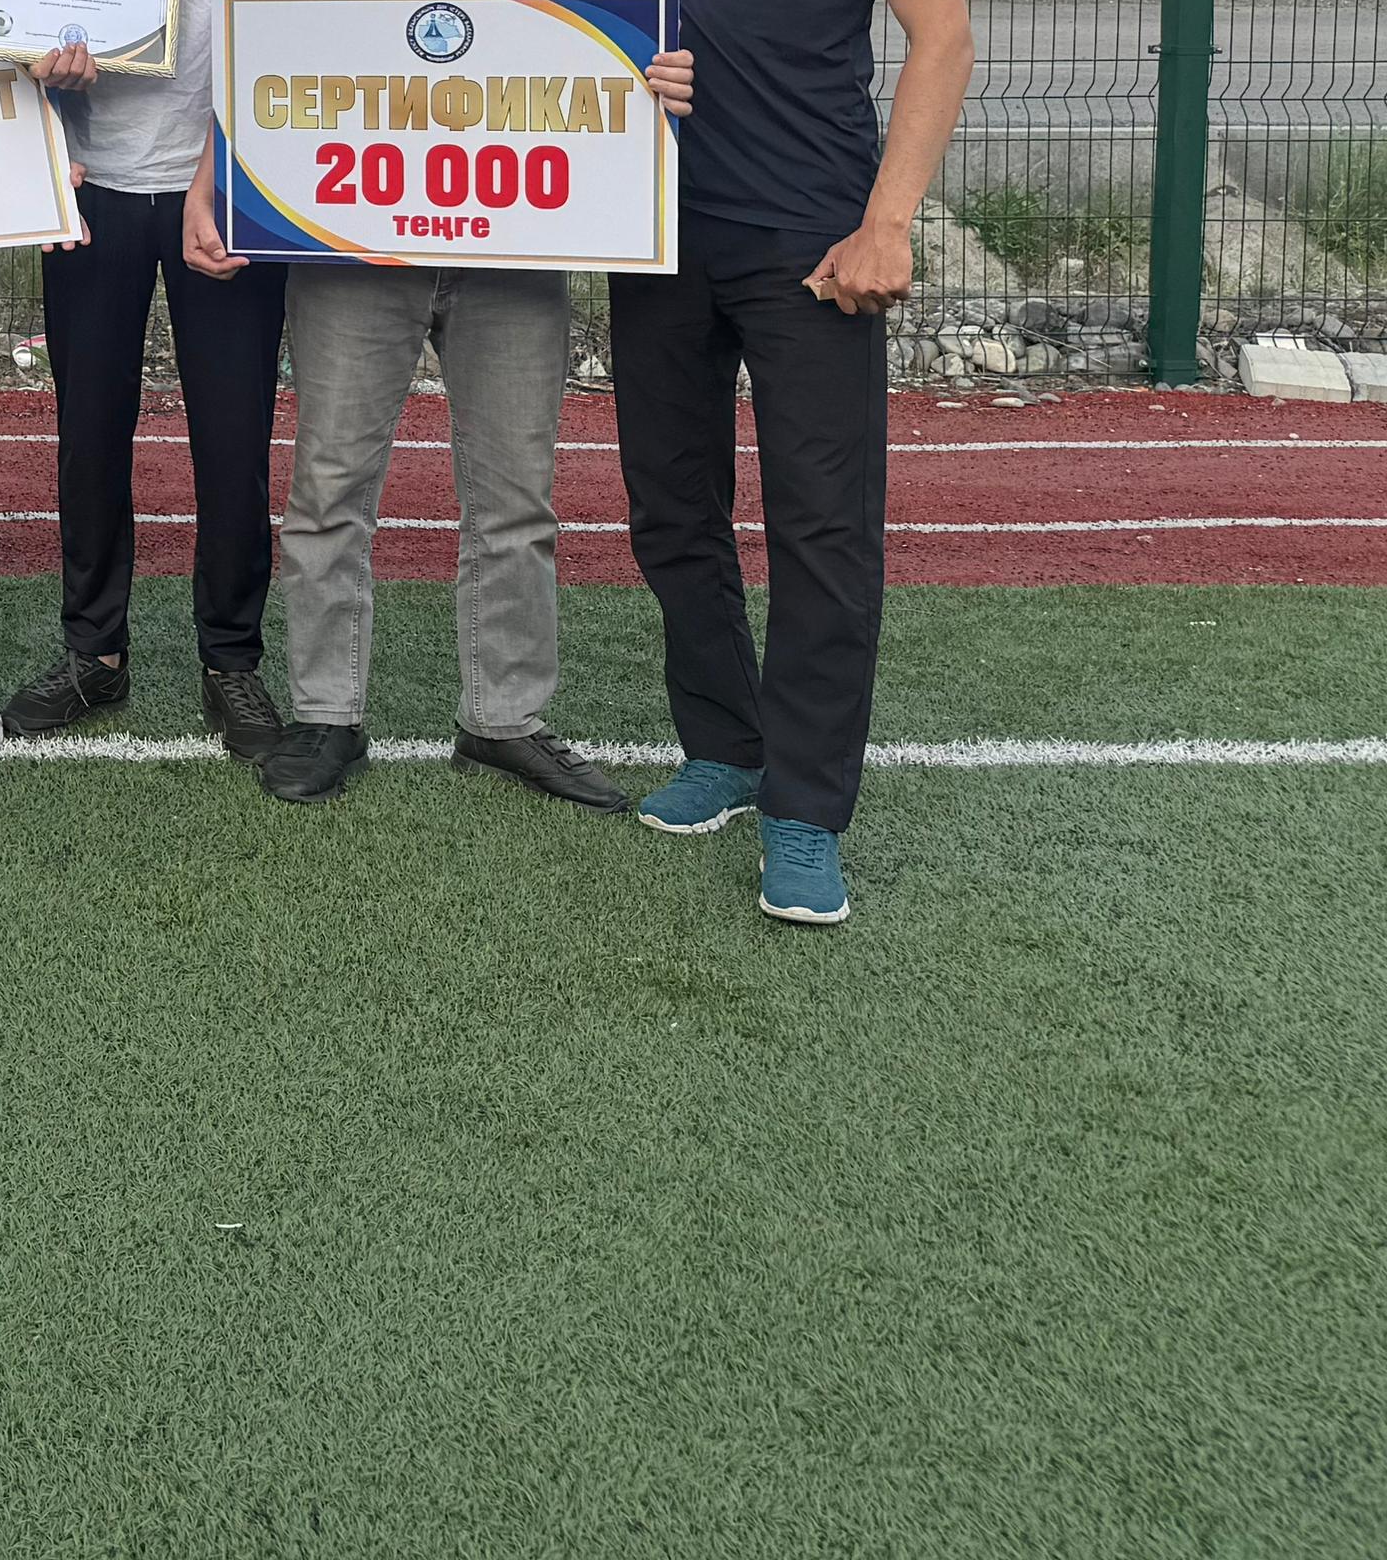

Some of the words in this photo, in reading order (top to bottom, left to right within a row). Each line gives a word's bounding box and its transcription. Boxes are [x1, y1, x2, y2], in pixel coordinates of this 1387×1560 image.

[252, 75, 634, 134] СЕРТИФИКАТ
[315, 143, 405, 207] 20
[425, 144, 570, 210] 000
[393, 214, 491, 241] теңге
